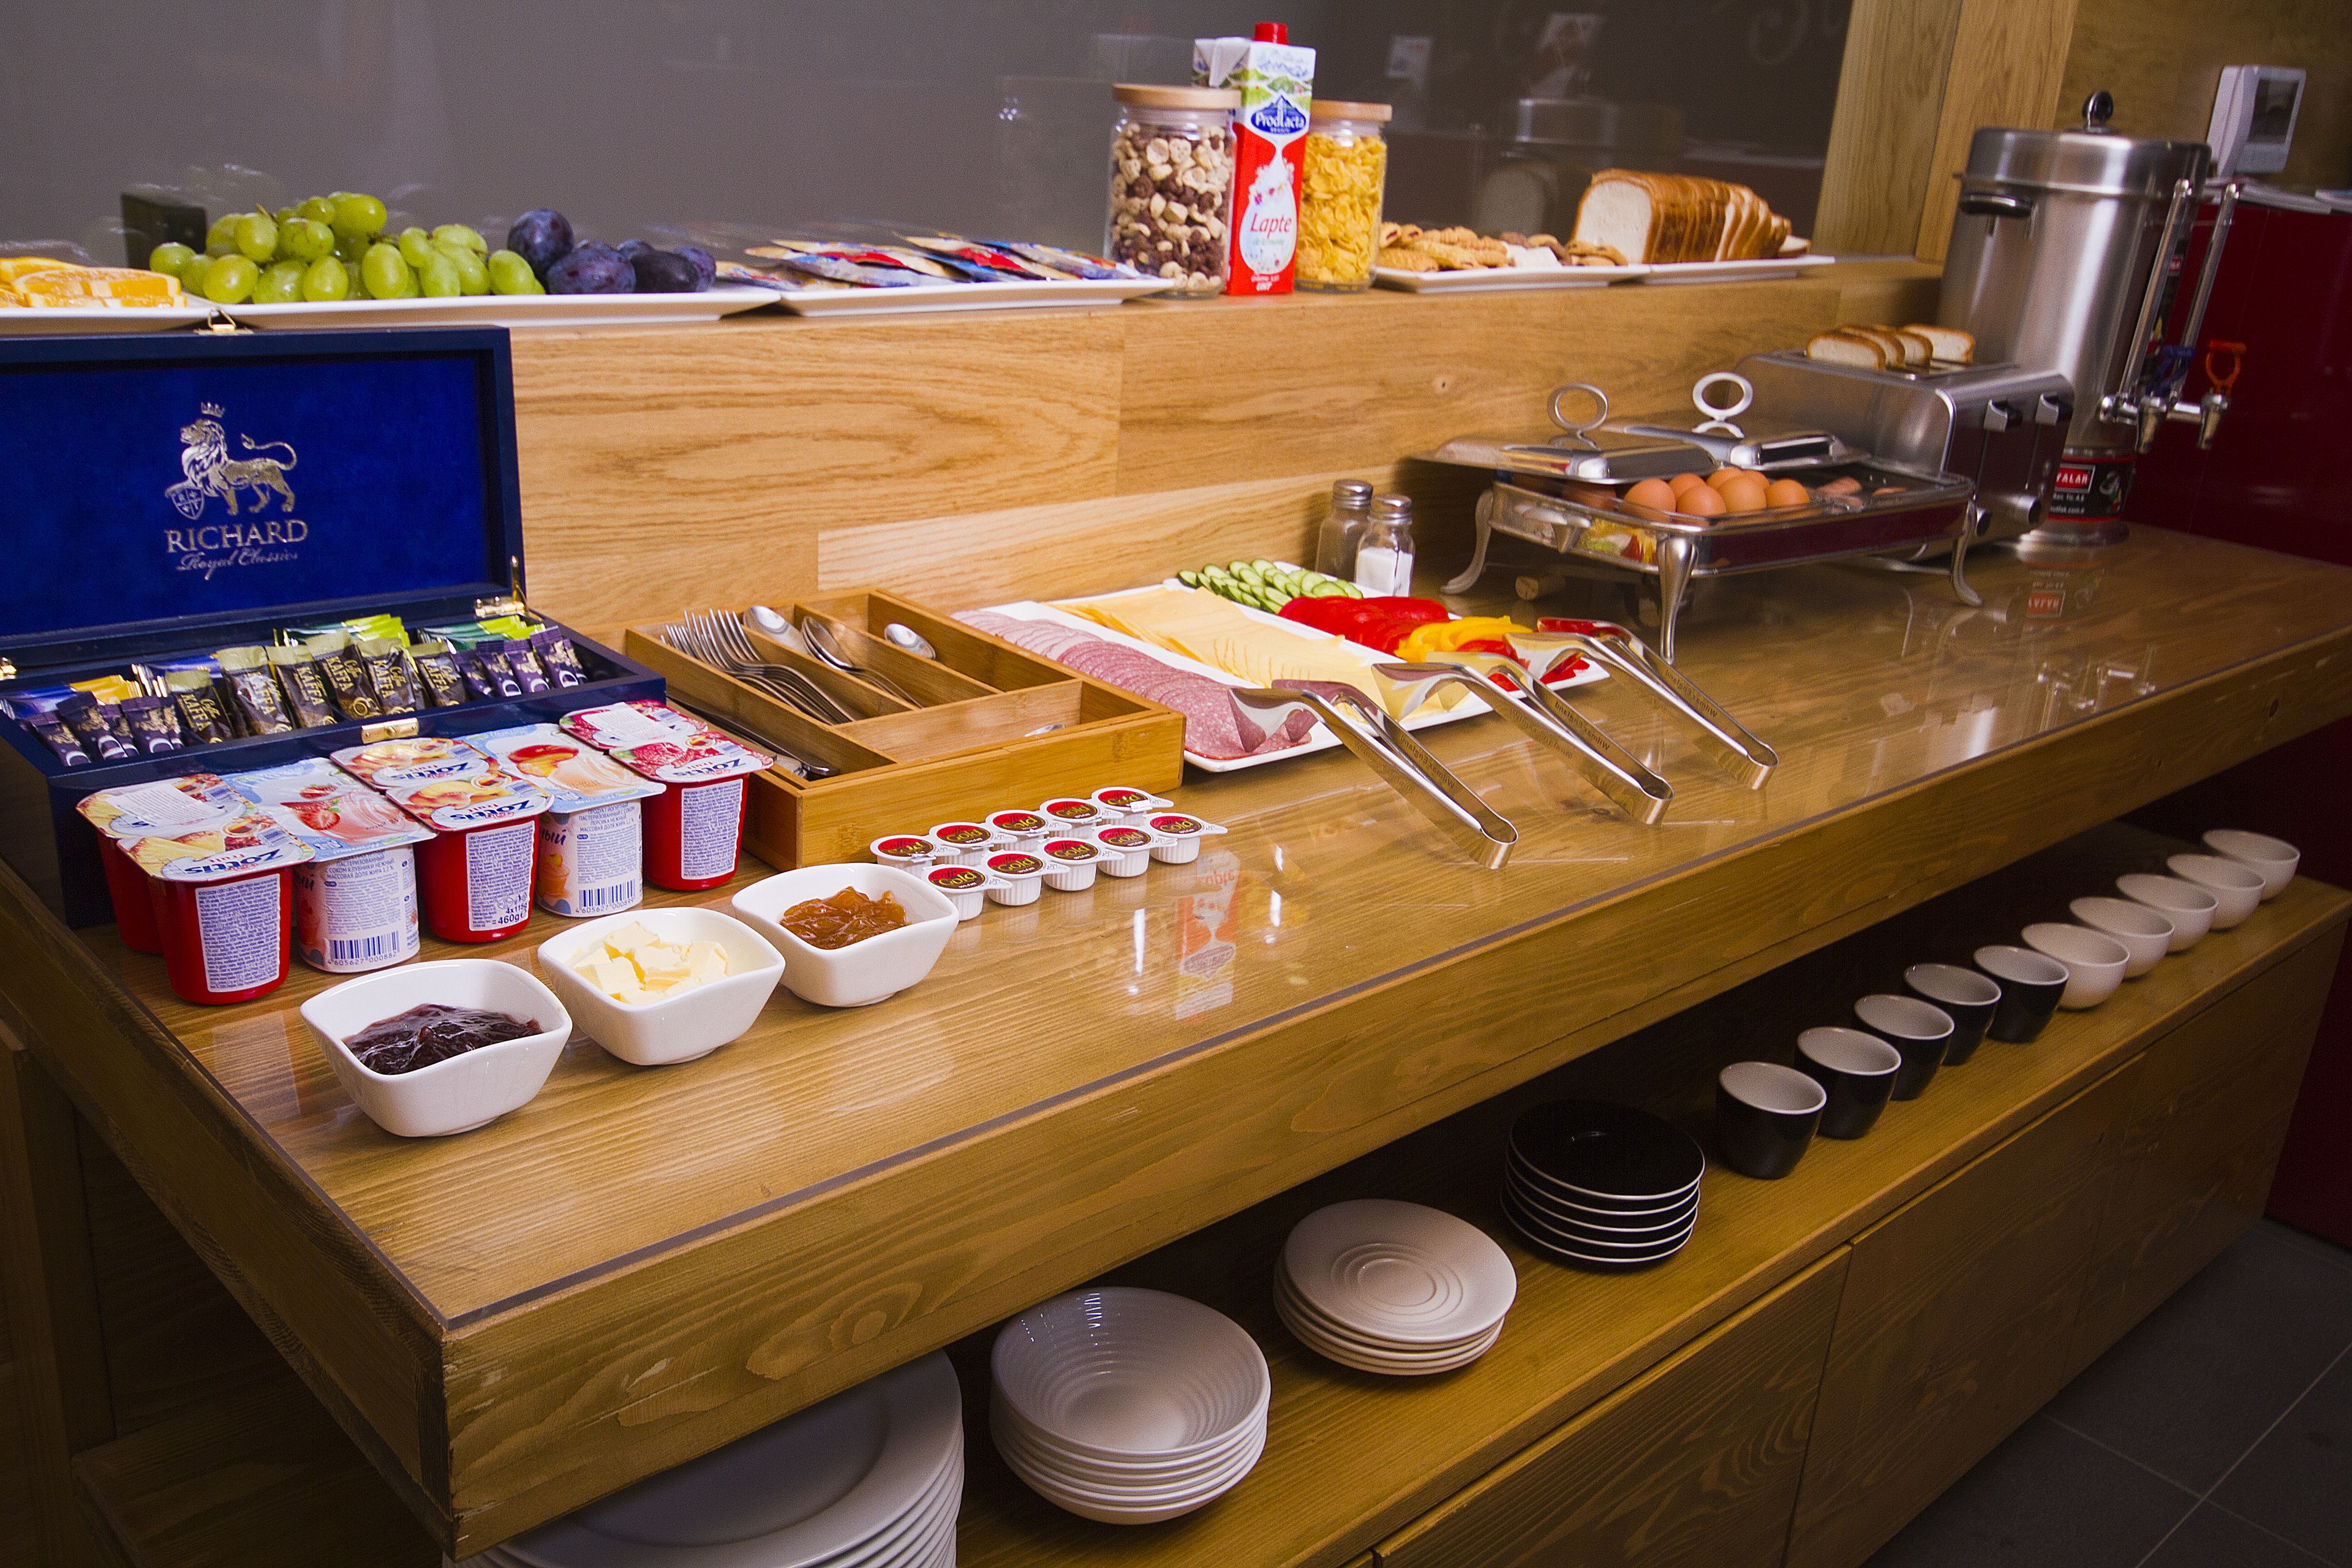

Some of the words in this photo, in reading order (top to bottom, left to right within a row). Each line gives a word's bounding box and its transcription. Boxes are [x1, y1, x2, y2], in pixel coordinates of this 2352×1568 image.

[1250, 213, 1292, 239] Lapte
[164, 519, 308, 553] RICHARD
[176, 548, 238, 581] Royal
[326, 655, 354, 692] KAFFA
[296, 666, 325, 706] KAFFA
[180, 693, 212, 732] KAFFA
[671, 758, 747, 777] Zottis
[450, 799, 534, 821] Zottis
[1056, 805, 1090, 816] Gold
[1159, 820, 1194, 832] Gold
[946, 829, 983, 842] Gold
[1108, 831, 1144, 844] Gold
[1054, 845, 1090, 857] Gold
[184, 849, 284, 875] Zottis
[997, 858, 1035, 871] Gold
[938, 871, 978, 886] Gold
[582, 903, 609, 914] 605627
[498, 914, 519, 924] 460g
[334, 957, 364, 967] 605627
[369, 952, 397, 963] 000882
